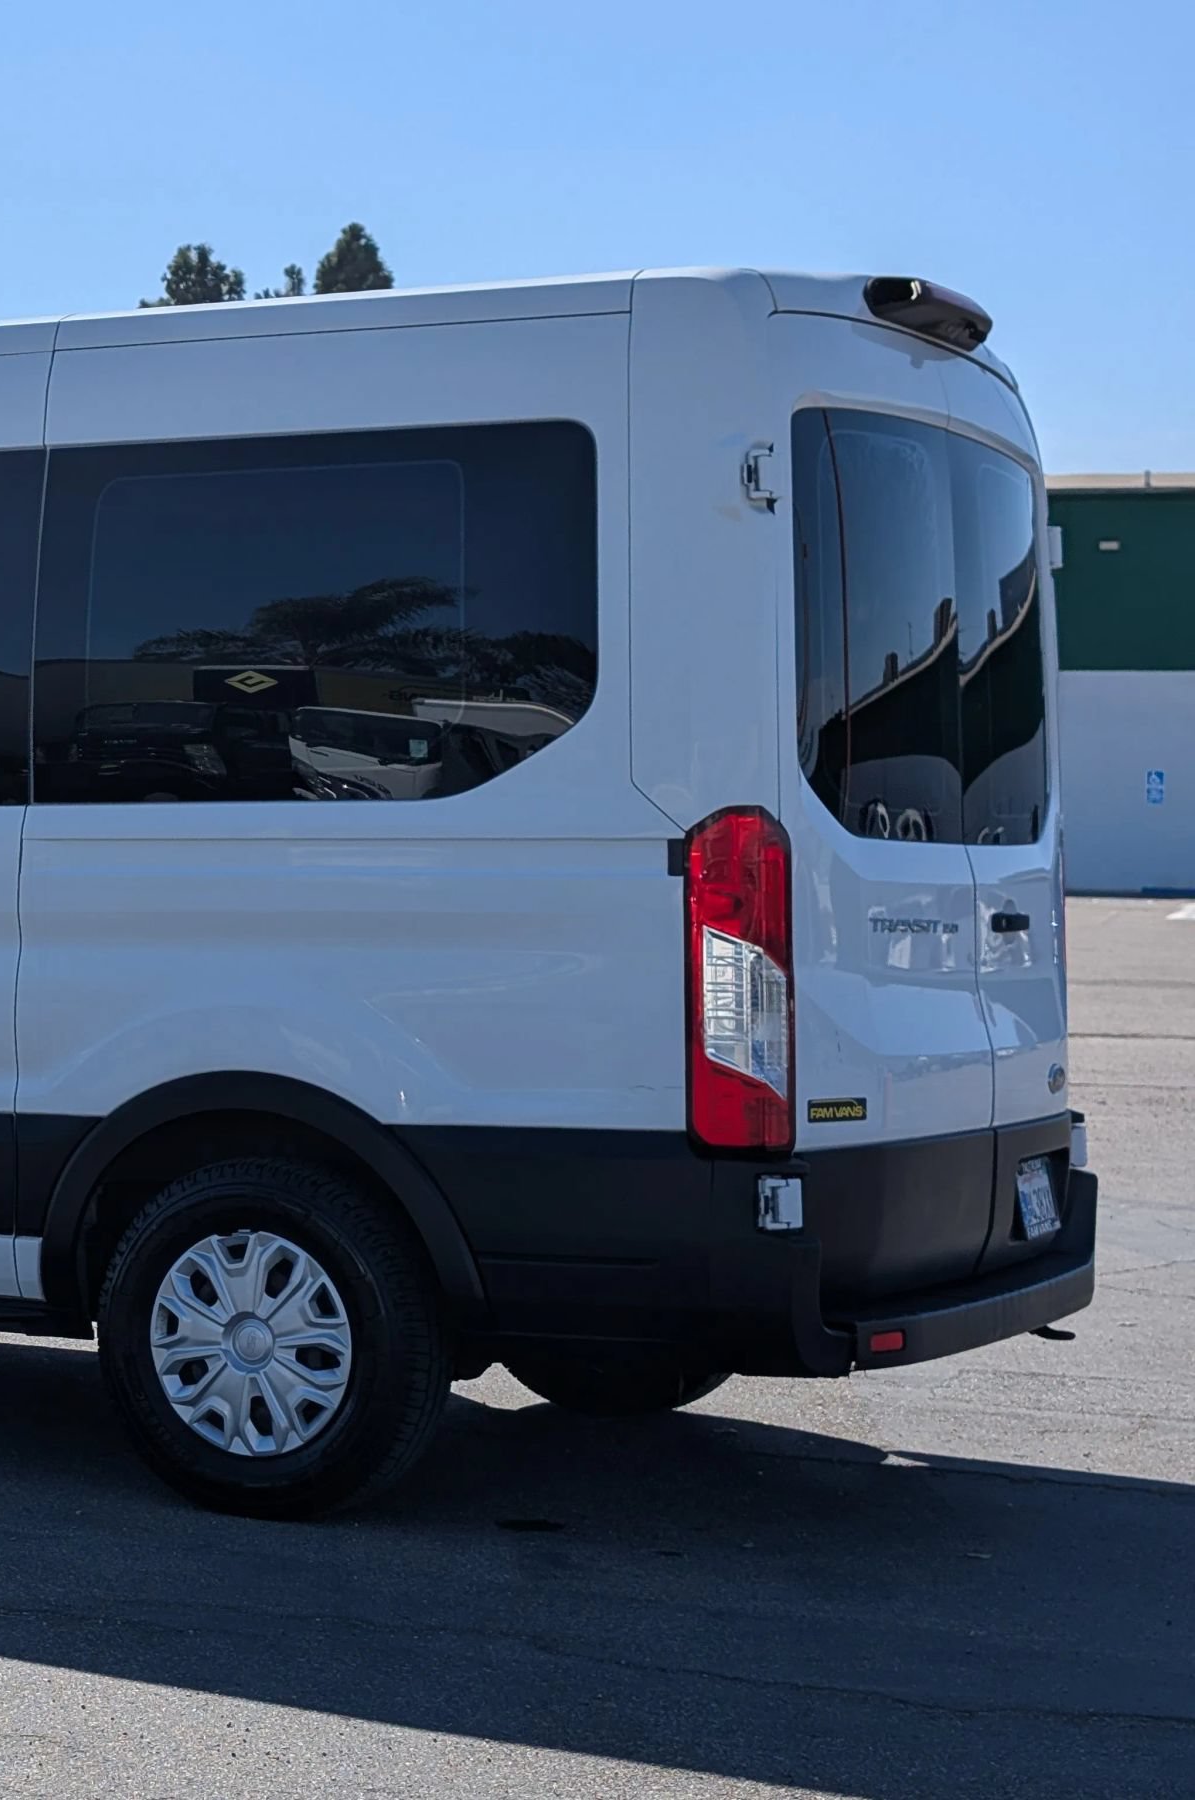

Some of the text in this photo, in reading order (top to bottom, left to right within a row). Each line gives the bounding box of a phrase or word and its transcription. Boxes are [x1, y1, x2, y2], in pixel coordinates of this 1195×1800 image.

[869, 918, 942, 933] TRANSIT
[810, 1105, 863, 1119] FAM VANS
